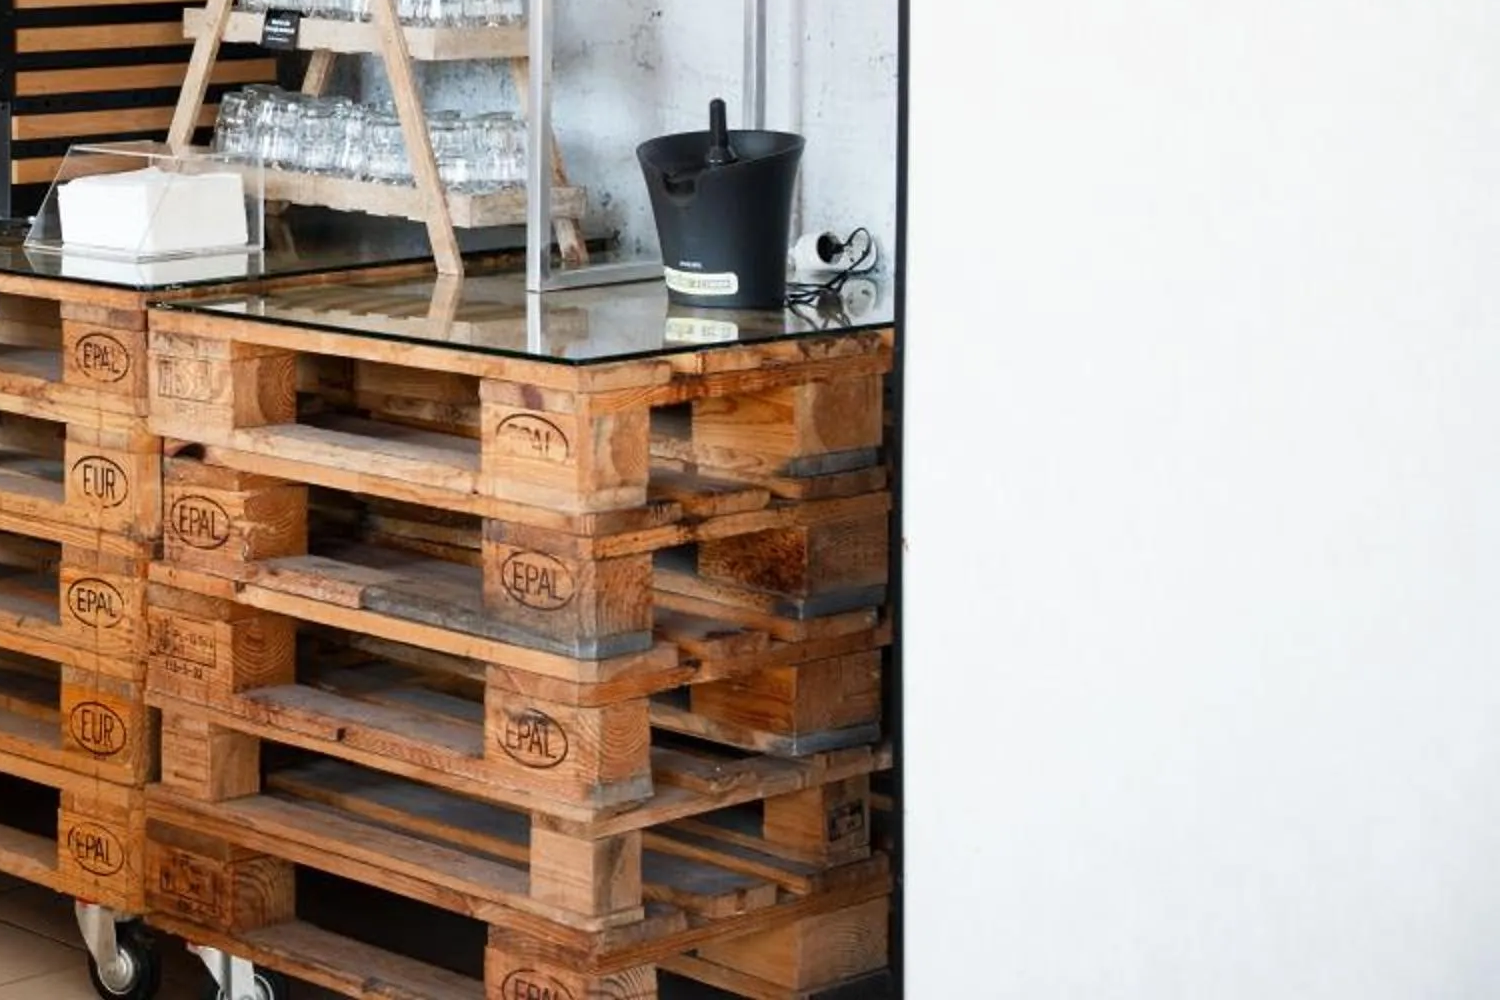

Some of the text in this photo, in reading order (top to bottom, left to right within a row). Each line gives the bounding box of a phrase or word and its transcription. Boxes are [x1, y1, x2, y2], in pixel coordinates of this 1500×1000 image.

[84, 343, 120, 374] EPAL
[83, 463, 116, 500] EUR
[178, 504, 223, 540] EPAL
[511, 560, 566, 602] EPAL
[76, 586, 117, 626] EPAL
[80, 709, 115, 749] EUR
[505, 722, 557, 759] EPAL
[74, 828, 113, 867] EPAL
